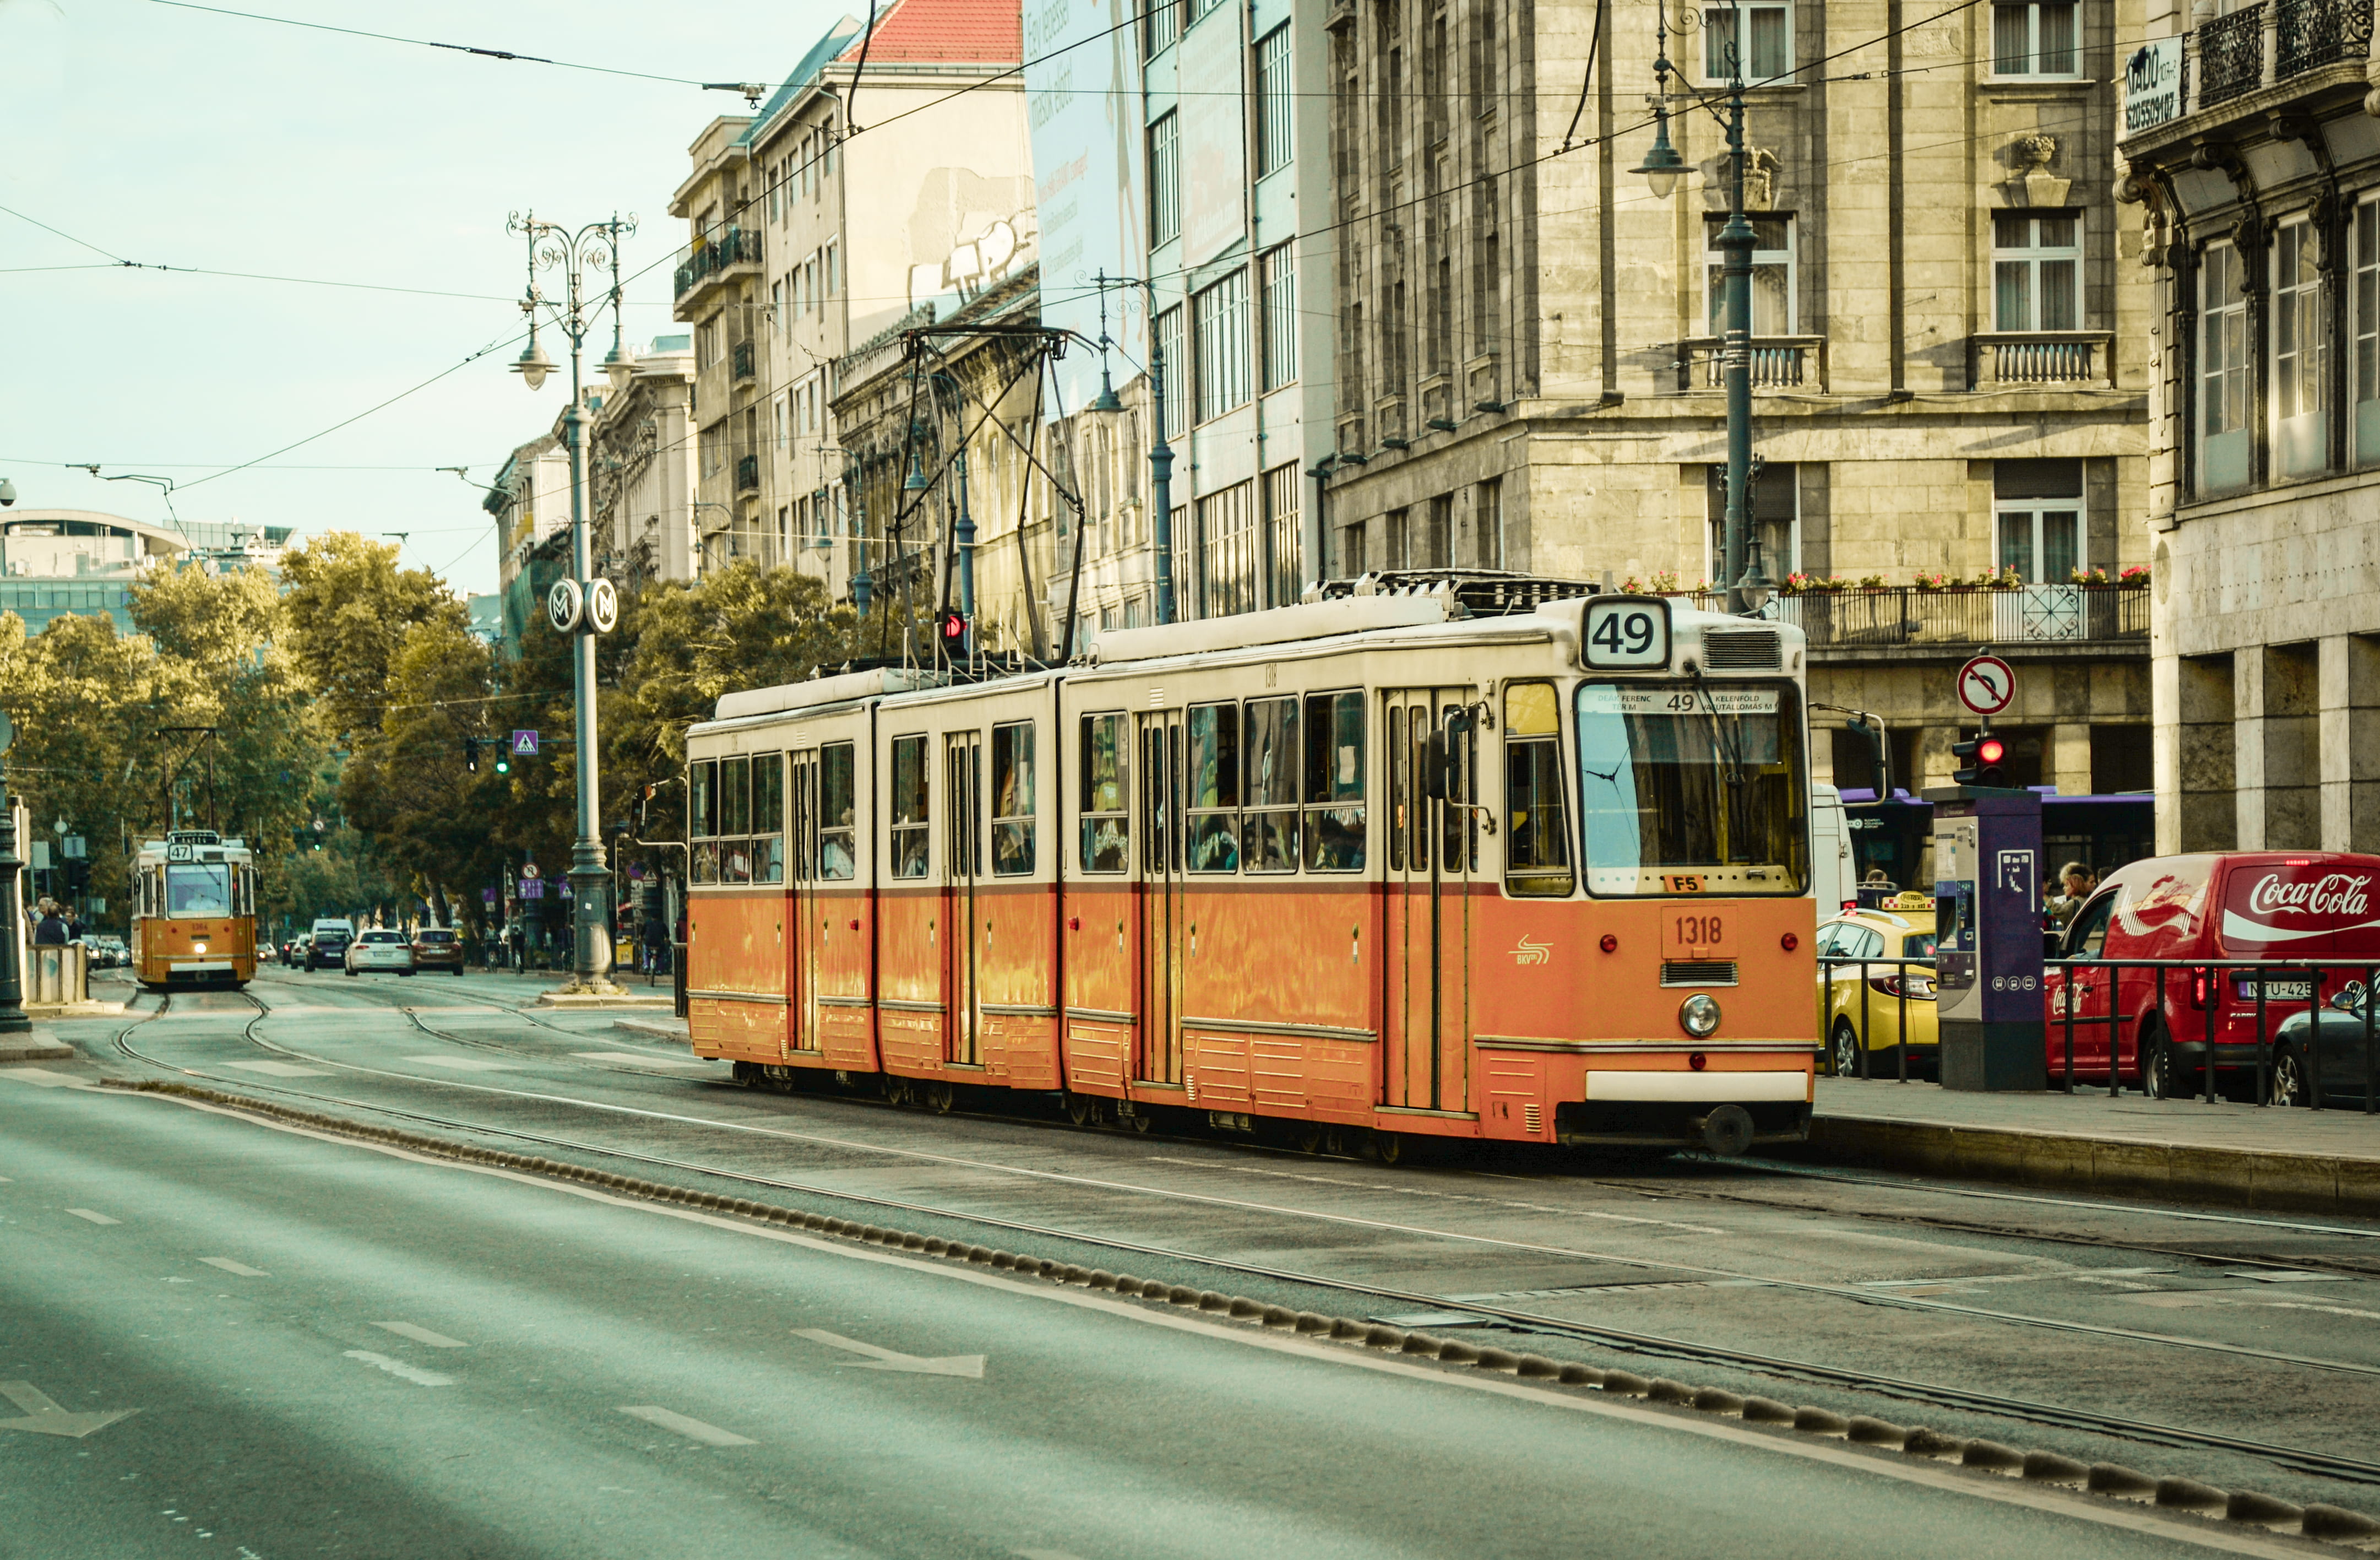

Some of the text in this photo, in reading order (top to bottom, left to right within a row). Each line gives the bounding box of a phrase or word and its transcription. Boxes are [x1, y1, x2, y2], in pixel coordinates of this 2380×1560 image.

[2127, 91, 2175, 131] 6205509107
[1592, 612, 1654, 654] 49
[1667, 694, 1694, 712] 49
[1703, 702, 1762, 711] VAÚTÁLLOMÁS
[1715, 694, 1760, 702] KELENFÖLD
[171, 847, 188, 858] 47
[1672, 876, 1698, 891] F5
[2249, 873, 2372, 915] Coca-Cola
[1676, 916, 1722, 945] 1318
